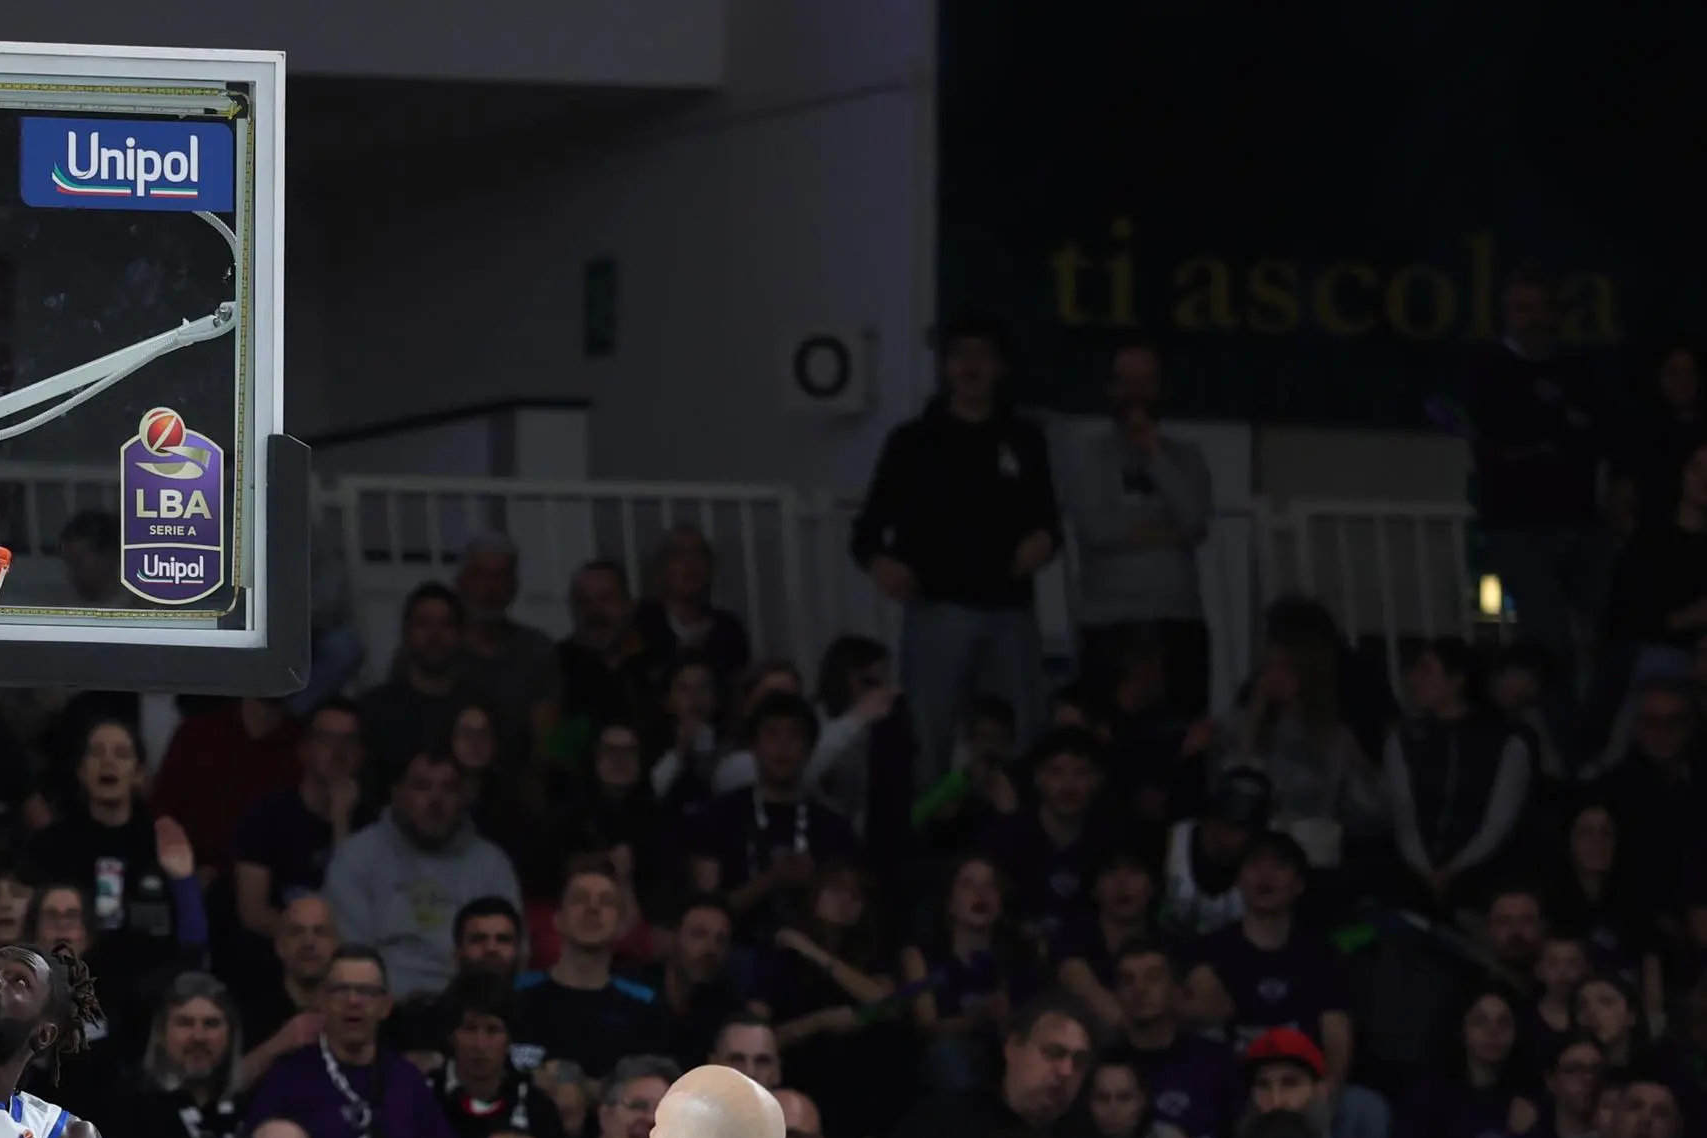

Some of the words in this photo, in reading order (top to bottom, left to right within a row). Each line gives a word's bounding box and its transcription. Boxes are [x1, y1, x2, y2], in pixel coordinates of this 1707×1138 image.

[66, 131, 199, 197] Unipol
[1171, 230, 1623, 346] ascola
[136, 488, 212, 520] LBA
[148, 524, 182, 538] SERIE
[185, 524, 197, 538] A
[143, 554, 205, 585] Unipol
